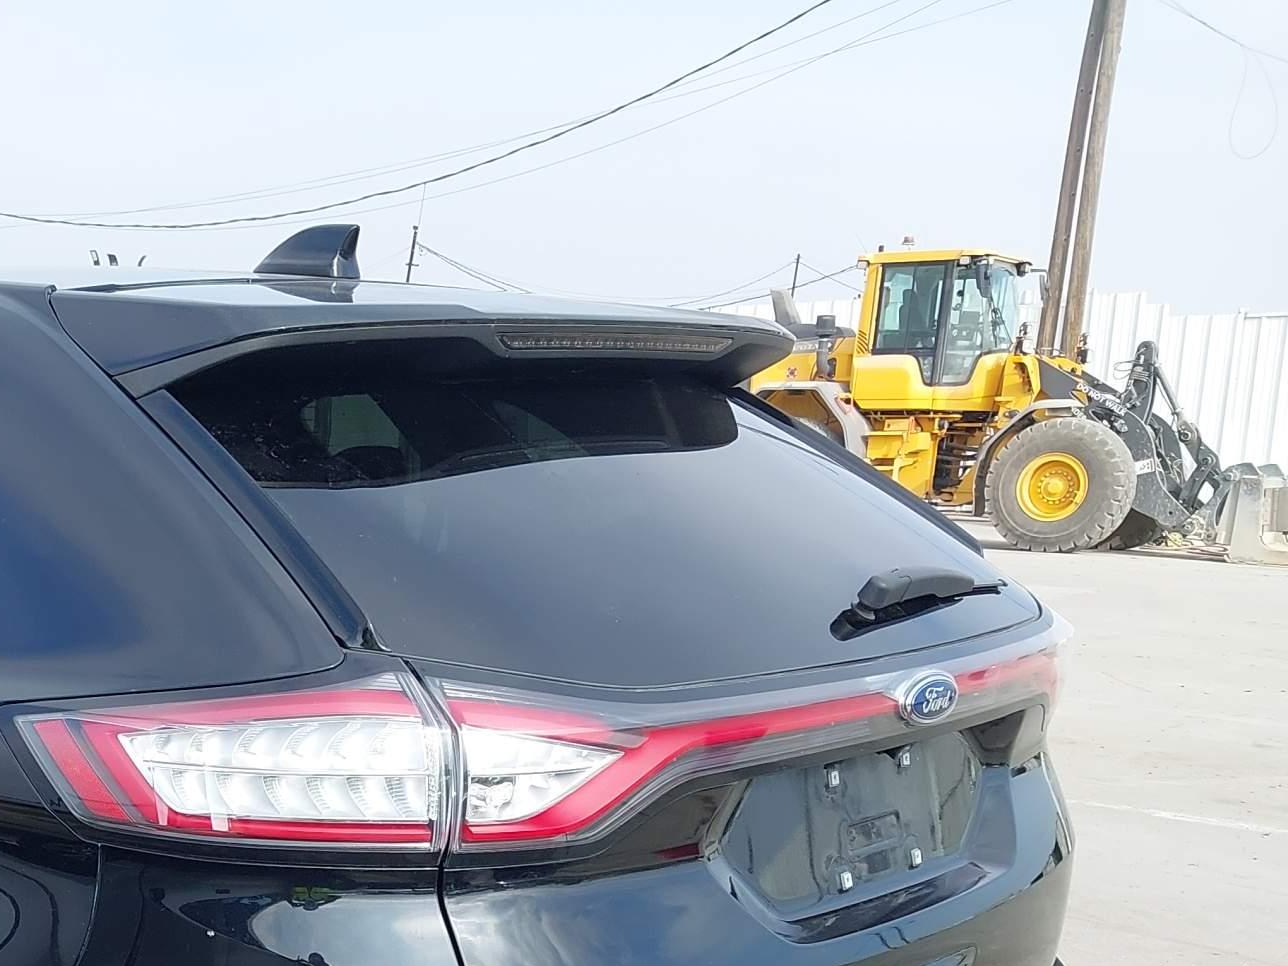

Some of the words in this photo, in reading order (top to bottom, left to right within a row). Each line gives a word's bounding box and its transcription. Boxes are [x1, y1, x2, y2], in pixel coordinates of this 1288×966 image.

[1076, 382, 1089, 393] DO
[1088, 390, 1105, 403] NOT
[1105, 401, 1128, 417] WALK
[923, 686, 951, 713] Ford
